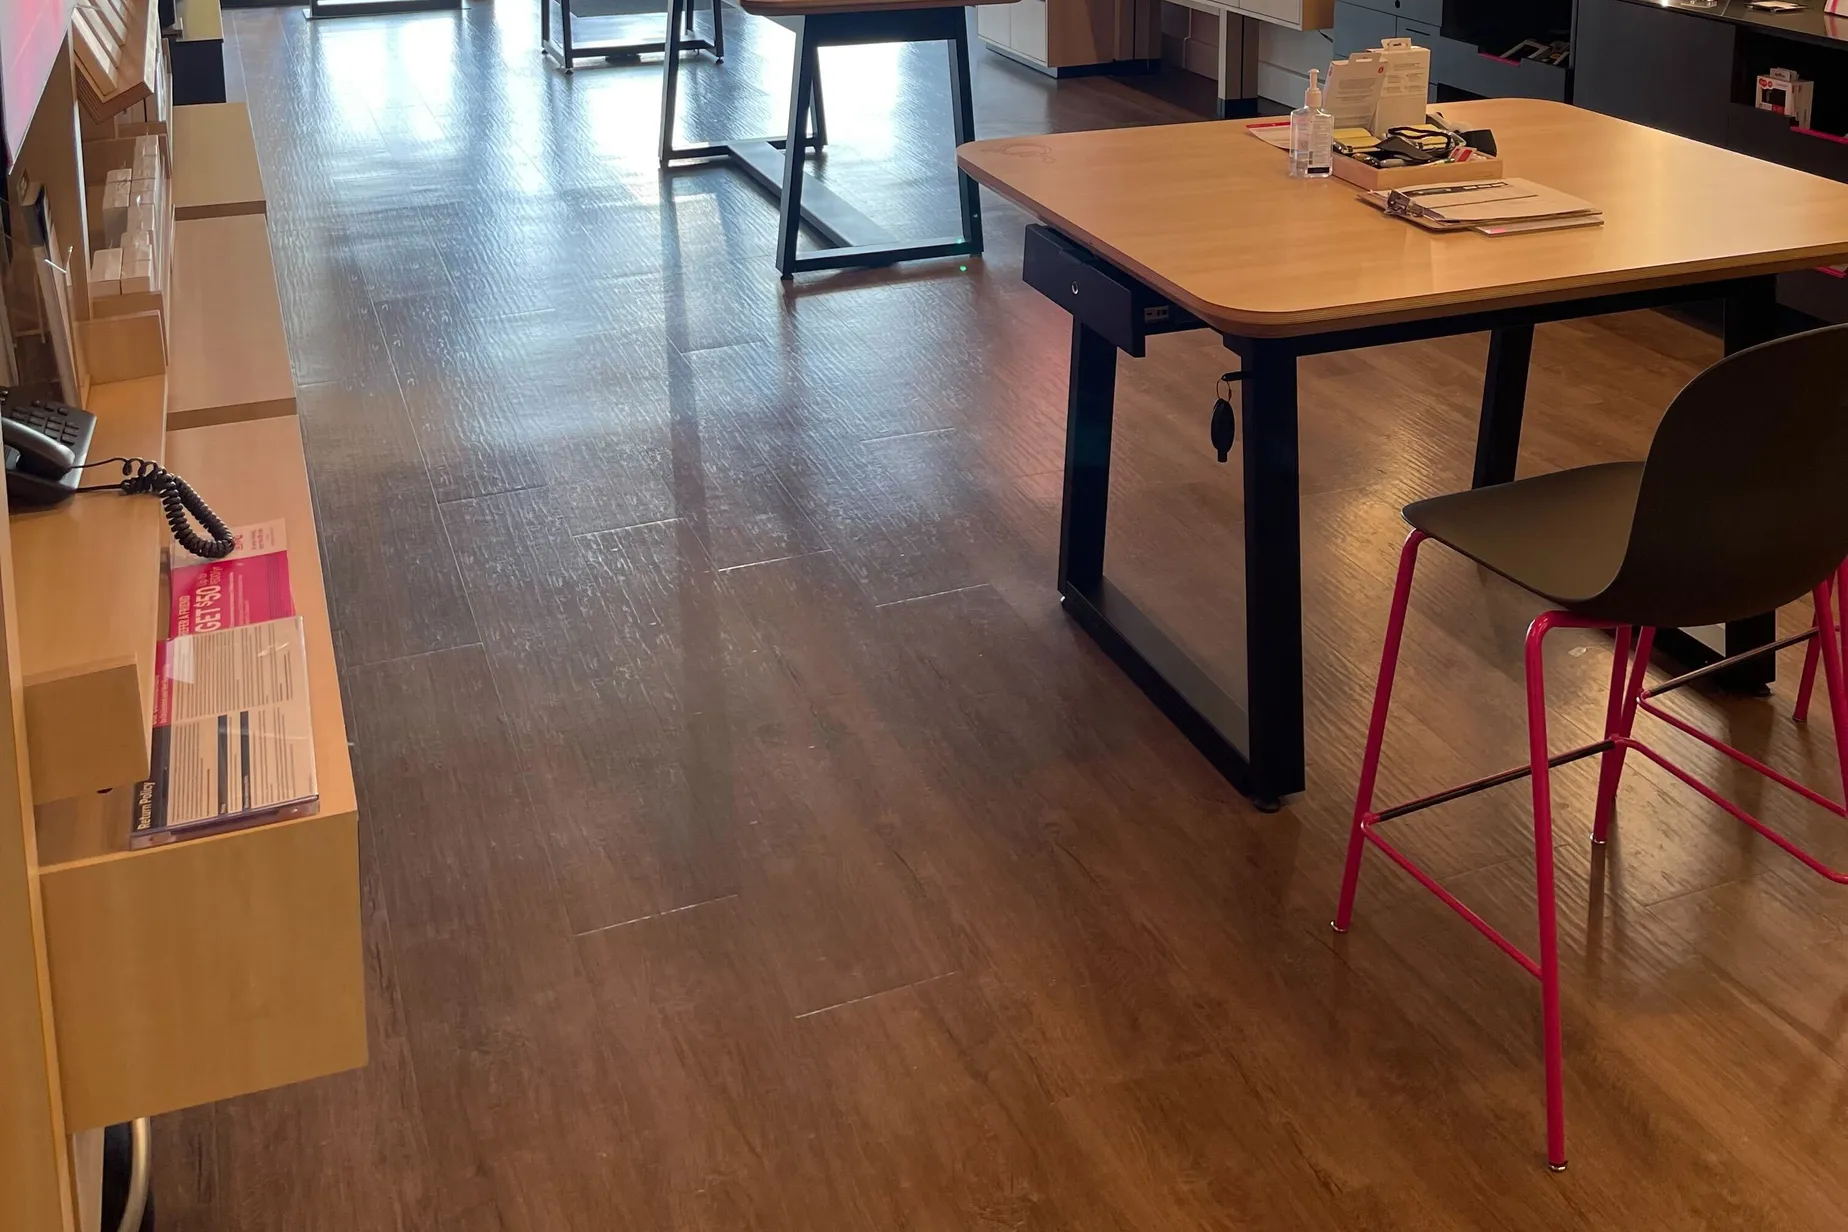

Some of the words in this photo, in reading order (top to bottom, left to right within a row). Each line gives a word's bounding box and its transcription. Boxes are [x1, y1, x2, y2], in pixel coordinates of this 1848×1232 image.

[193, 585, 221, 608] $50
[195, 608, 221, 632] GET
[138, 781, 156, 805] Policy
[136, 804, 151, 830] Return
